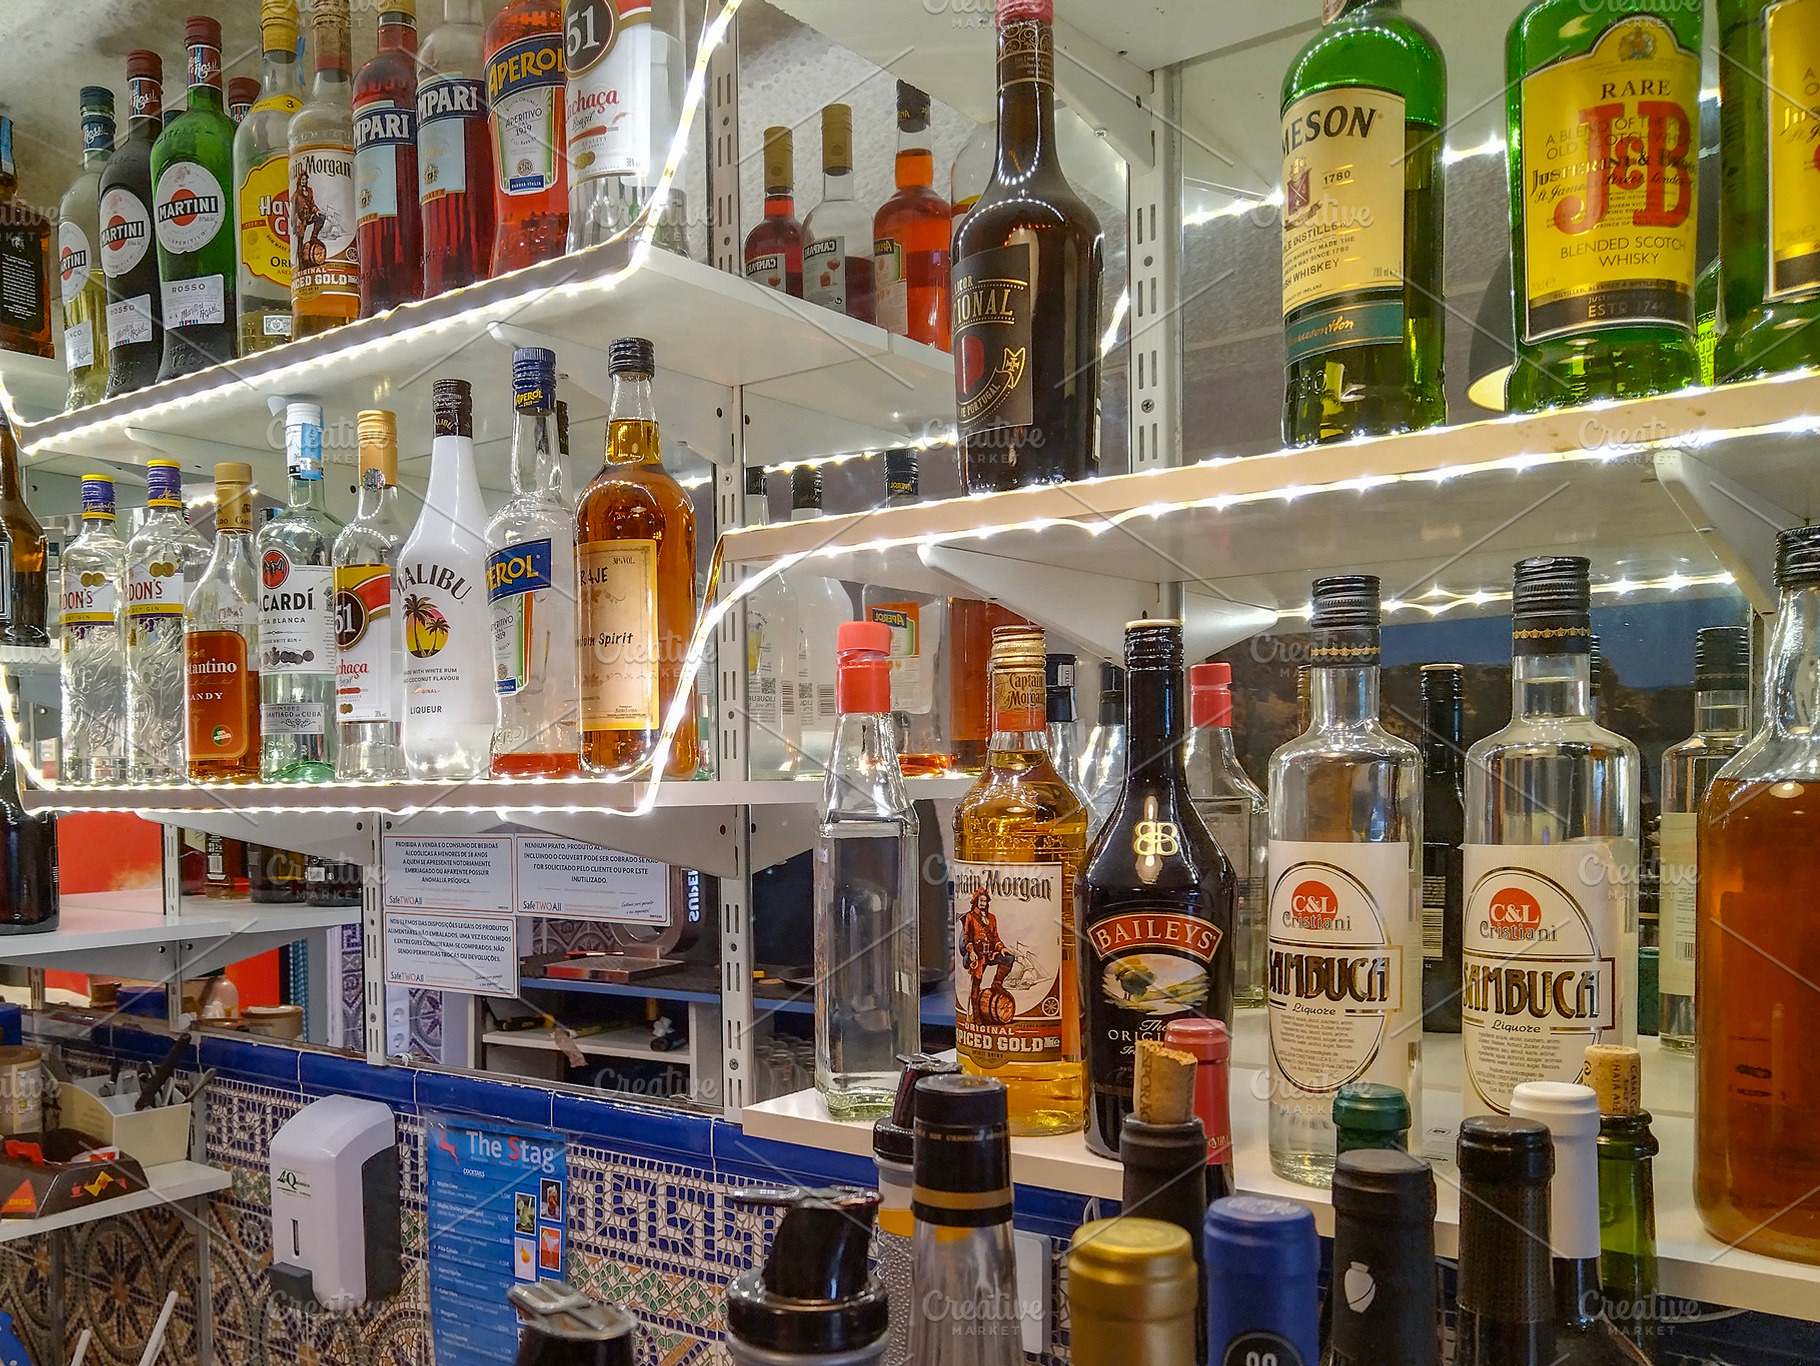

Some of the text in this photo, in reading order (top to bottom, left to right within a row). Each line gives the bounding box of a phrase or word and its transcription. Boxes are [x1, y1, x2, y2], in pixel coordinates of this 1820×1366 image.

[566, 6, 599, 56] 51
[488, 48, 564, 105] APEROL
[1600, 79, 1672, 100] RARE
[286, 100, 294, 108] 3
[505, 108, 542, 128] APERITIVO
[516, 126, 532, 136] 1919
[1546, 134, 1555, 147] A
[1614, 118, 1635, 130] OF
[1547, 143, 1578, 160] OLD
[1638, 152, 1650, 166] &
[303, 155, 353, 179] Morgan
[1324, 170, 1351, 184] 1780
[160, 197, 216, 220] MARTINI
[1293, 220, 1348, 247] DISTILLED
[1293, 247, 1317, 261] WHISKEY
[1319, 240, 1338, 250] MADE
[1311, 251, 1330, 261] SINCE
[1560, 236, 1686, 259] BLENDED SCOTCH
[1599, 253, 1660, 267] WHISKY
[1293, 258, 1339, 282] WHISKEY
[315, 274, 347, 285] GOLD
[172, 284, 206, 294] ROSSO
[516, 389, 543, 406] APEROL
[967, 383, 1000, 416] PORTUGAL
[581, 567, 608, 586] RAJE
[272, 616, 306, 624] BLANCA
[335, 603, 356, 634] 51
[598, 632, 633, 648] Spirit
[1009, 673, 1043, 690] Captain
[410, 706, 442, 715] LIQUEUR
[572, 876, 608, 884] INUTILIZADO.
[982, 869, 1053, 902] Morgan
[1293, 894, 1337, 915] C&L
[1282, 910, 1352, 932] Cristiani
[1490, 903, 1541, 925] C&L
[428, 921, 458, 929] DISPOSIÇÕES
[1479, 919, 1558, 942] Cristiani
[430, 930, 458, 939] EMBALADOS,
[481, 934, 511, 942] ESCOLHIDOS
[1096, 919, 1215, 950] BAILEYS
[413, 949, 441, 957] PERMITIDAS
[461, 942, 493, 951] COMPRADOS,
[1292, 1002, 1337, 1017] Liquore
[964, 1023, 1015, 1035] ORIGINAL
[1491, 1020, 1541, 1033] Liquore
[997, 1036, 1044, 1052] GOLD
[466, 1131, 555, 1174] The Stag
[463, 1168, 485, 1178] COCKTAILS
